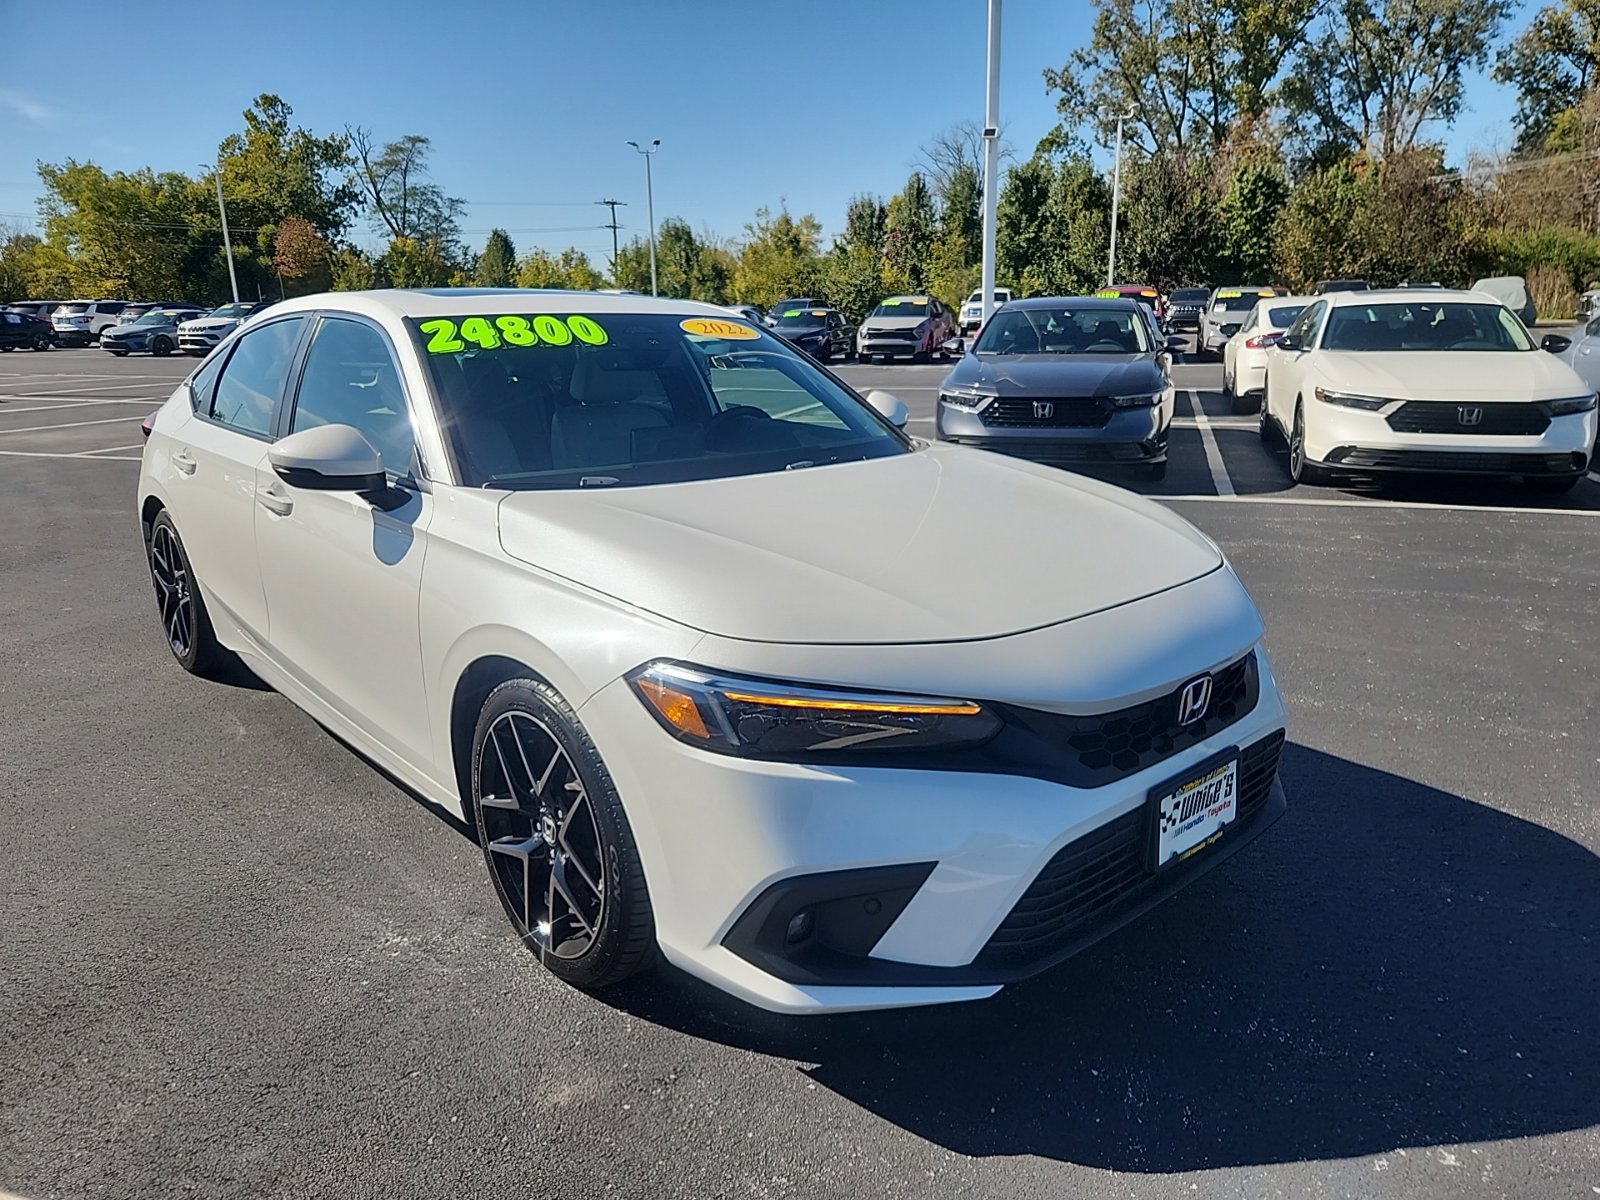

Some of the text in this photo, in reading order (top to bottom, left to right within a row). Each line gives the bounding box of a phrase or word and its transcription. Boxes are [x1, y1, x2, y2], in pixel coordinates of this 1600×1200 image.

[420, 316, 608, 353] 24800
[696, 322, 748, 335] 2022
[1182, 800, 1231, 832] Honda Toyota
